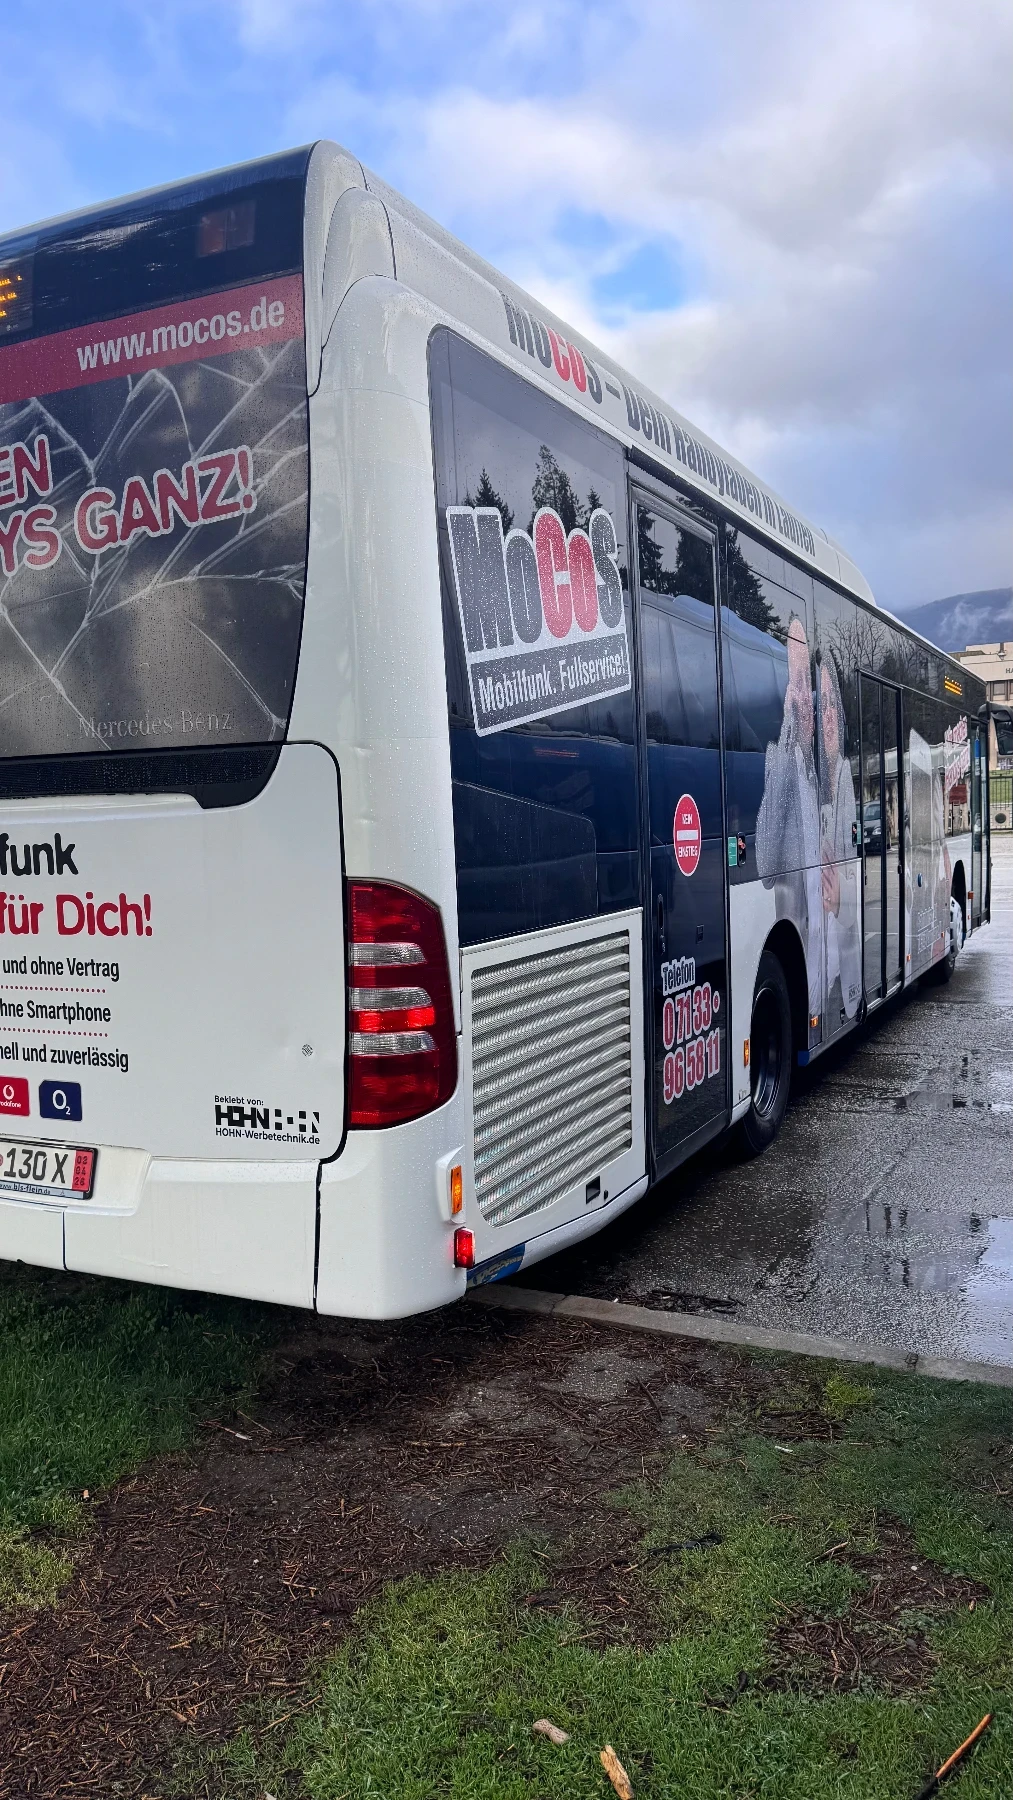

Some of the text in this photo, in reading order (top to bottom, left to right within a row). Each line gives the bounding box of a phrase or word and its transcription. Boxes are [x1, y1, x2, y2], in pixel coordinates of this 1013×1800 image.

[77, 297, 285, 371] www.mocos.de
[76, 446, 256, 553] GANZ!
[559, 645, 626, 692] Fullservice!
[678, 845, 698, 858] EINSTIEG
[56, 891, 152, 937] Dich!
[3, 956, 120, 983] und ohne Vertrag
[662, 958, 695, 993] Telefon
[27, 1000, 111, 1025] Smartphone
[22, 1044, 47, 1063] und
[50, 1046, 129, 1073] zuverlässig
[214, 1095, 265, 1106] Beklebt von:
[215, 1127, 321, 1145] HOHN-Werbetechnik.de
[3, 1147, 69, 1184] 130 X
